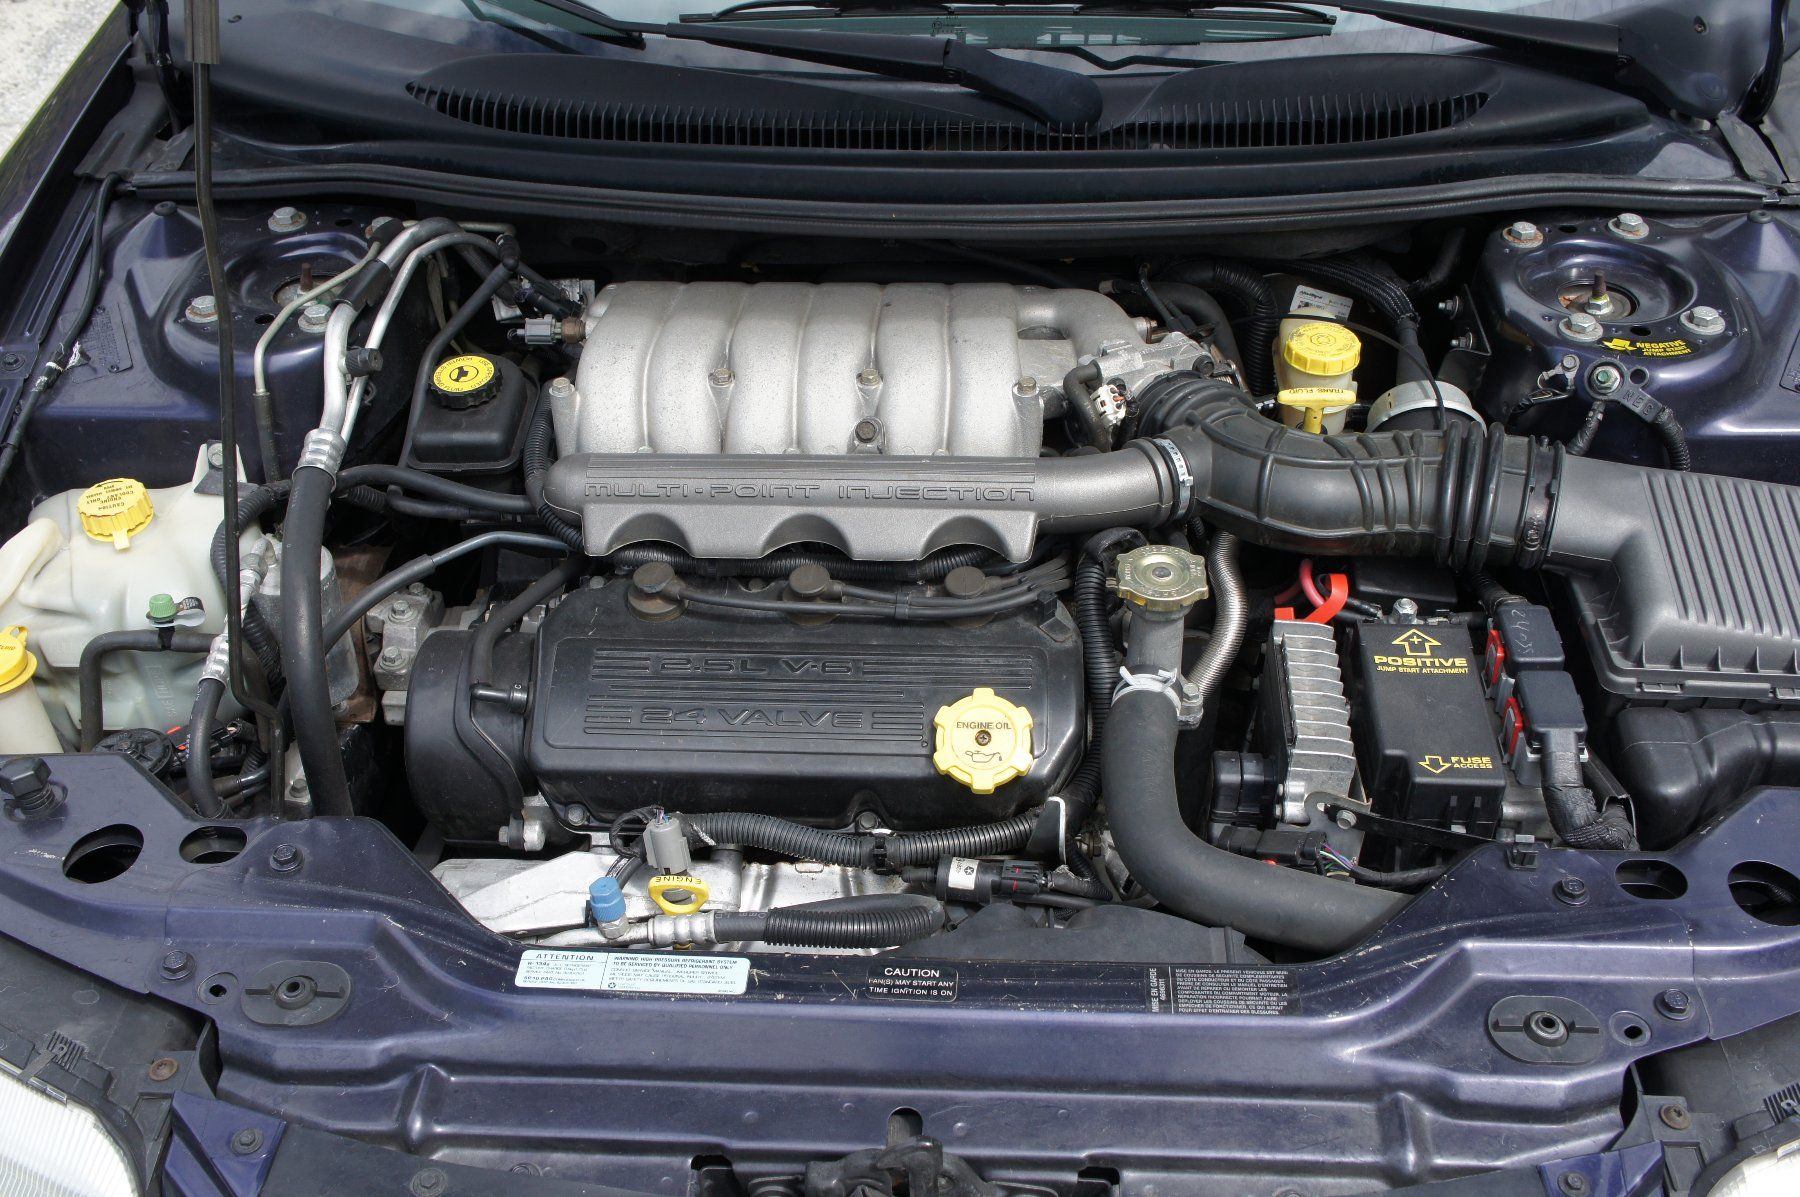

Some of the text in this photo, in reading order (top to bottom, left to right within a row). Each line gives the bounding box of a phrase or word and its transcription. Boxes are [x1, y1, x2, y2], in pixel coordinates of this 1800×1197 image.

[1636, 340, 1686, 348] NEGATIVE
[838, 486, 1034, 501] INJECTION
[660, 657, 766, 674] 2.5L
[1374, 656, 1468, 666] POSITIVE
[641, 708, 863, 728] 24 VALVE
[655, 876, 702, 885] ENGINE
[884, 968, 939, 977] CAUTION
[1149, 968, 1158, 987] GARDE
[1151, 988, 1158, 996] EN
